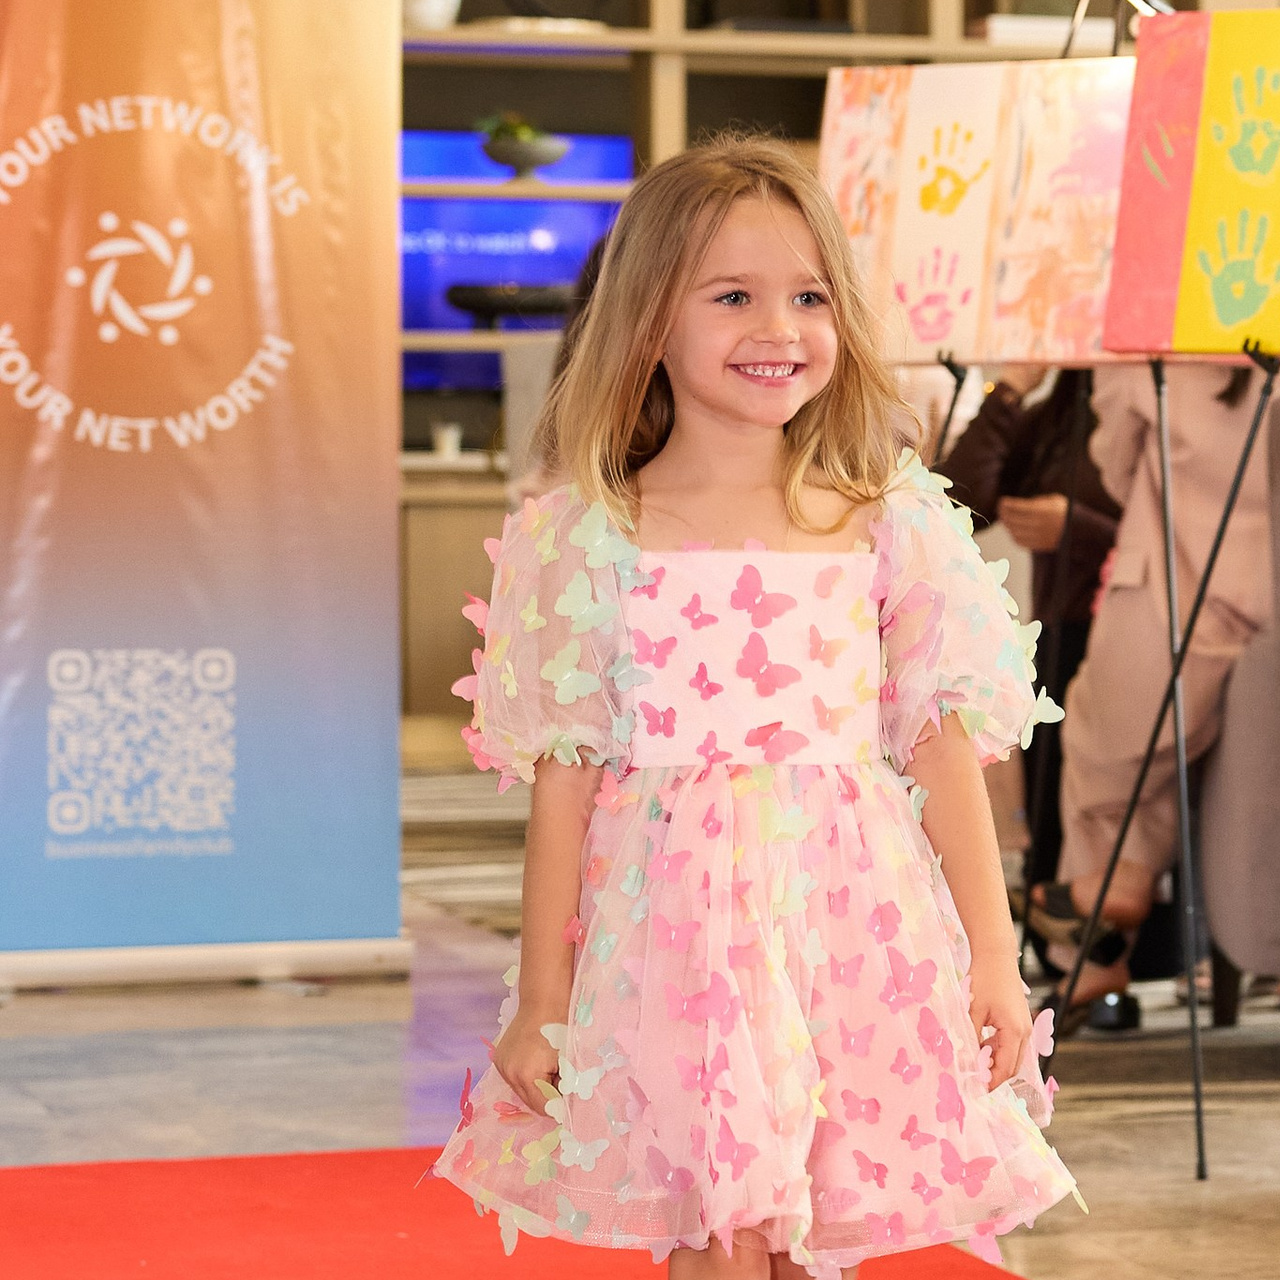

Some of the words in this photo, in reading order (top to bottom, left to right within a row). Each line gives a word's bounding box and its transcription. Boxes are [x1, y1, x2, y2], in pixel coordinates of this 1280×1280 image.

[270, 173, 310, 216] IS
[74, 406, 158, 453] NET
[162, 333, 294, 448] WORTH
